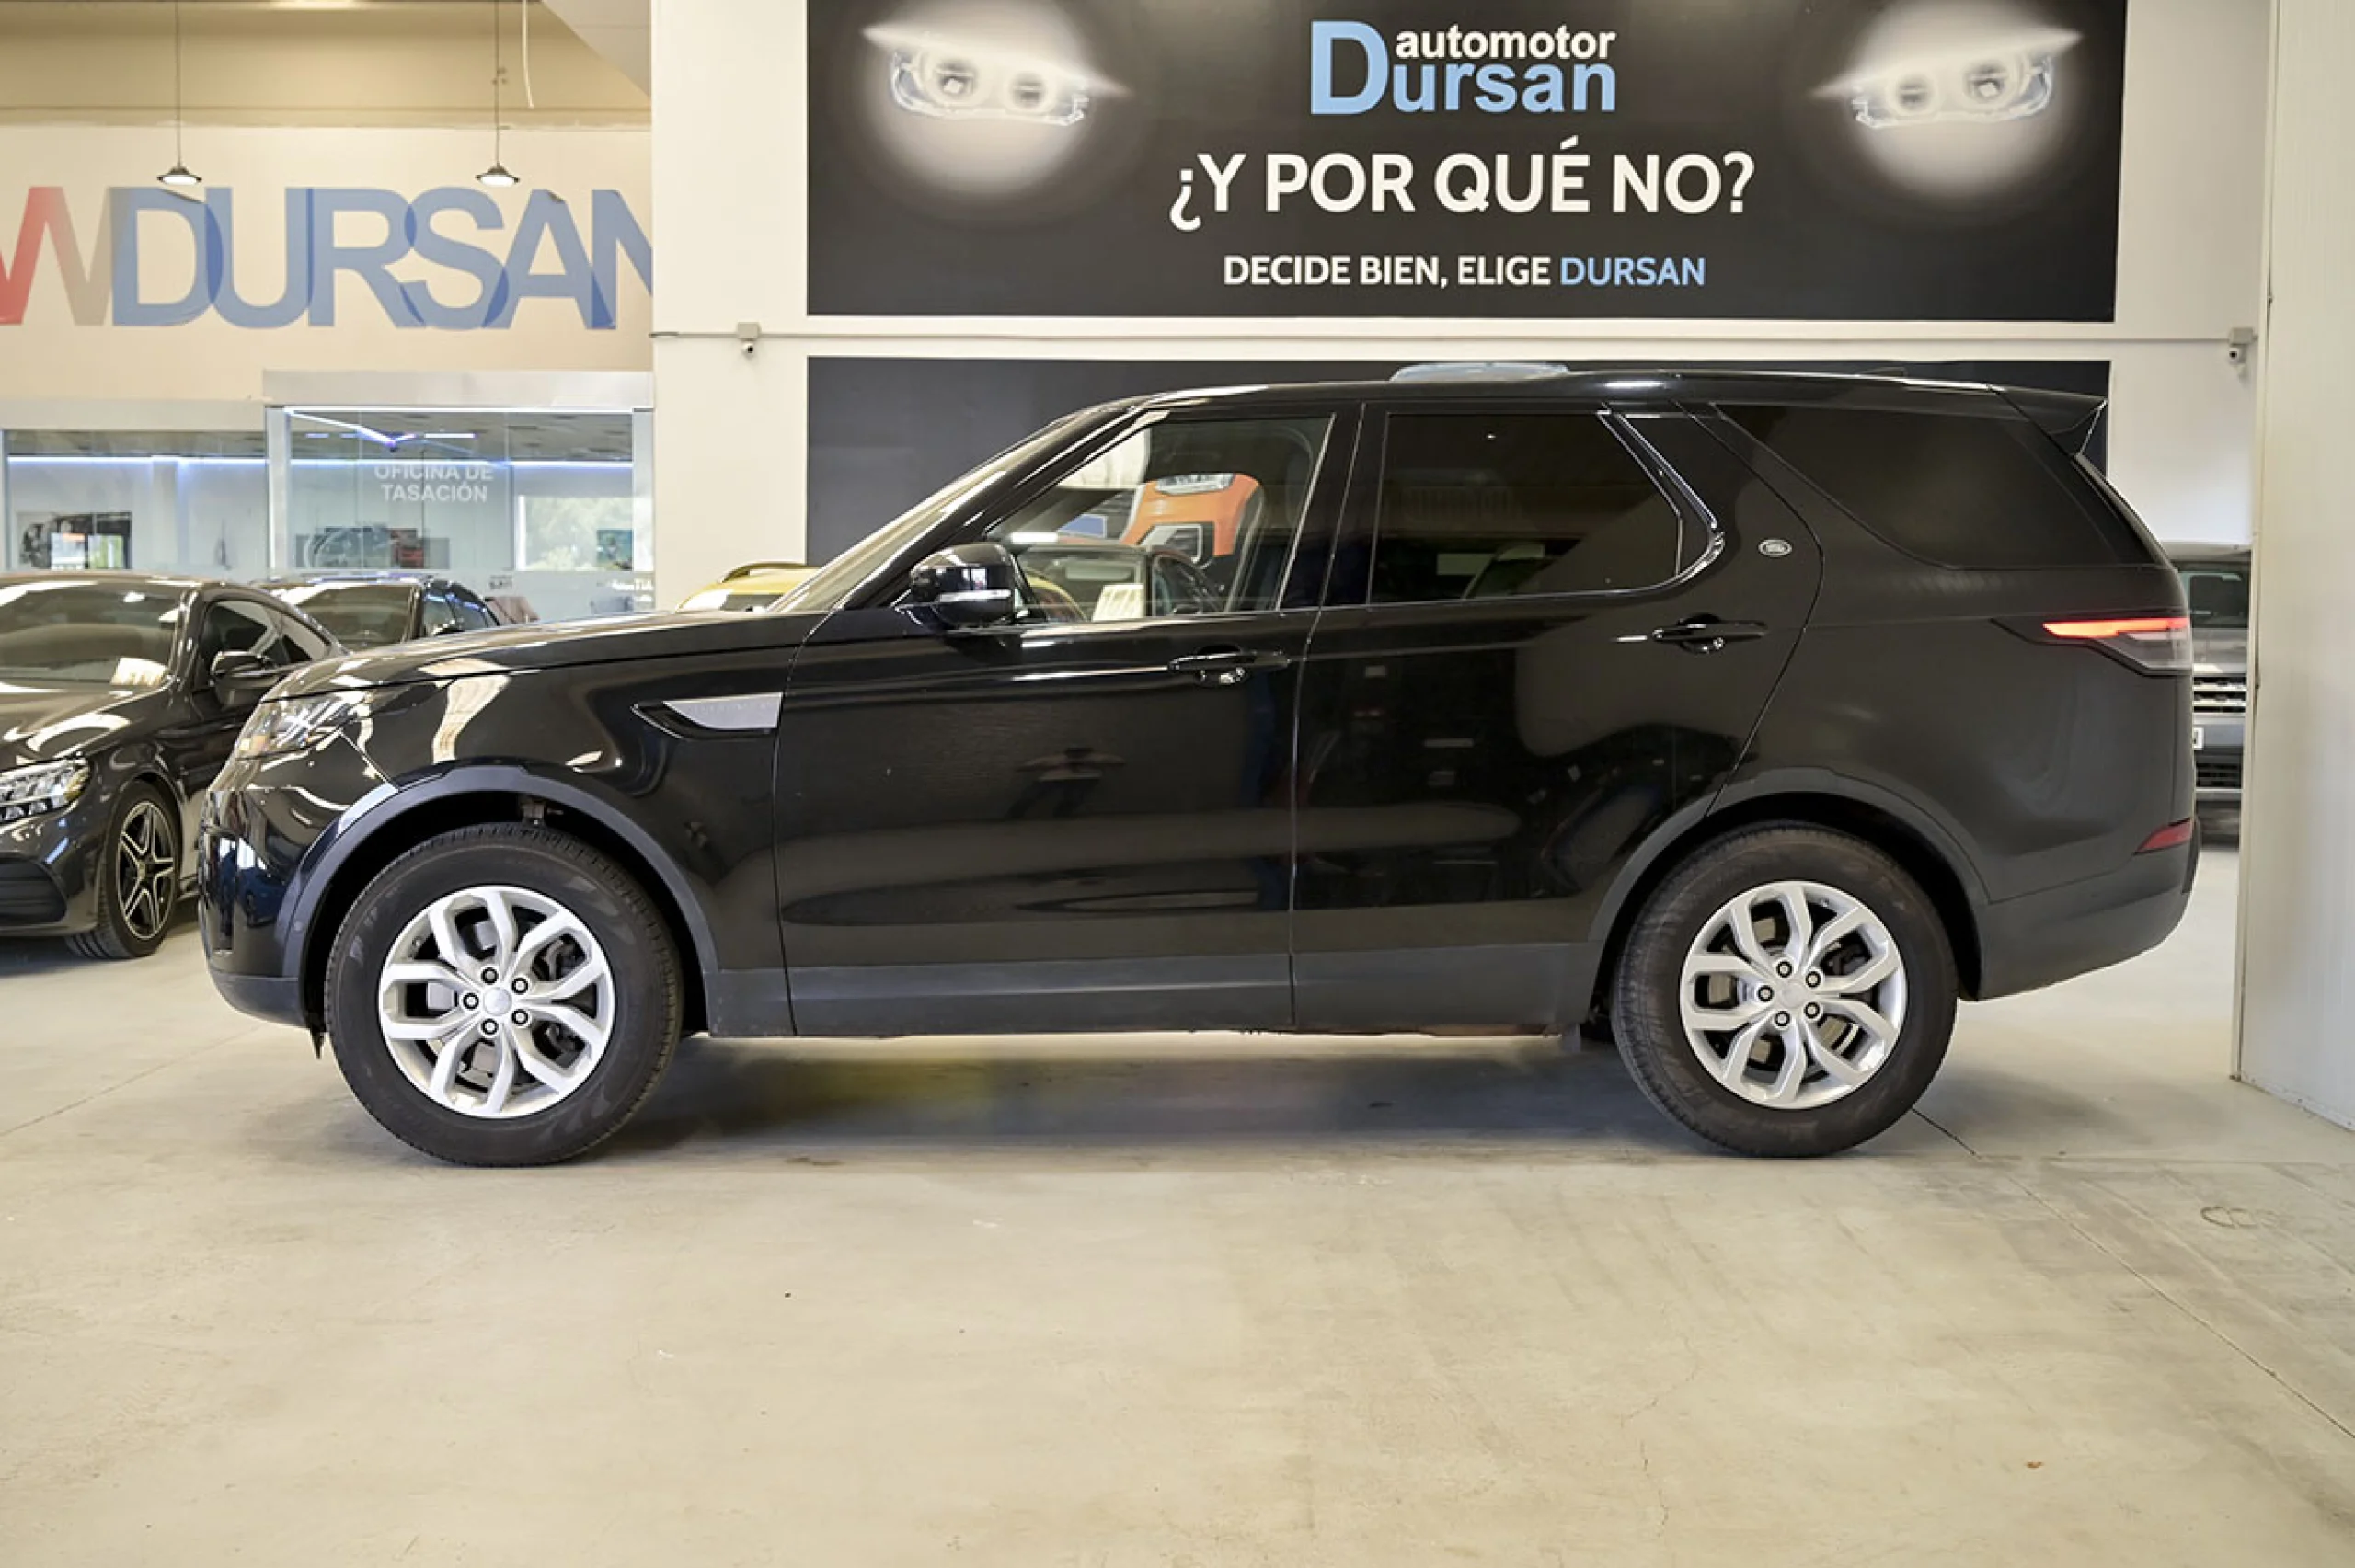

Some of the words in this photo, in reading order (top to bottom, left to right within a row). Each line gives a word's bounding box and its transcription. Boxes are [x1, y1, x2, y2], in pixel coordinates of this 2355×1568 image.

[1396, 24, 1617, 60] automotor
[1310, 20, 1616, 115] Dursan
[1169, 153, 1247, 231] ¿Y
[1265, 152, 1416, 213] POR
[1434, 134, 1591, 213] QUÉ
[1613, 150, 1755, 214] NO?
[1223, 255, 1351, 286] DECIDE
[1360, 255, 1448, 289] BIEN,
[1457, 255, 1551, 286] ELIGE
[1560, 256, 1706, 286] DURSAN
[373, 464, 460, 479] OFICINA
[465, 464, 494, 479] DE
[380, 480, 488, 501] TASACIÓN
